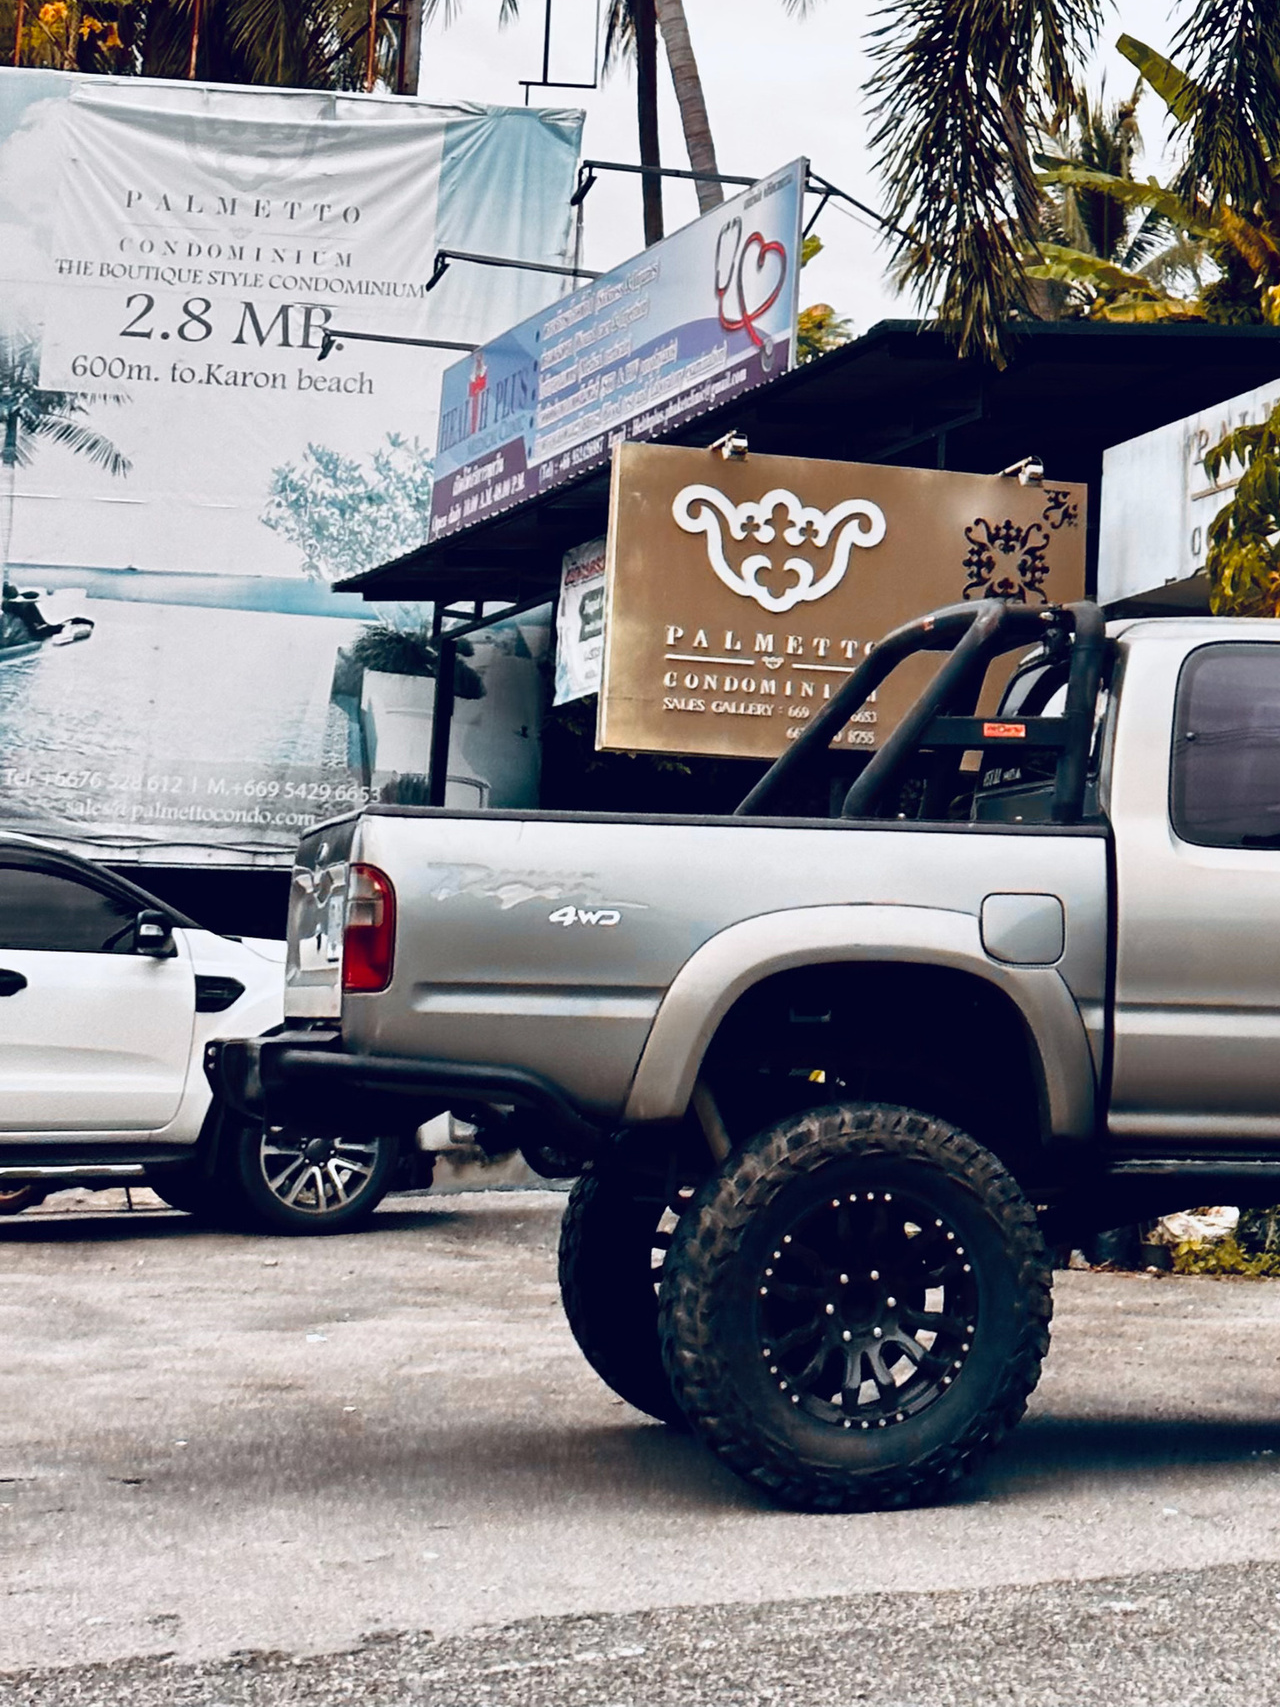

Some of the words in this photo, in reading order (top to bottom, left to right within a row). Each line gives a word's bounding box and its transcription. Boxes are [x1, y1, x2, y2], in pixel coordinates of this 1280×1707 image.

[127, 190, 361, 224] PALMETTO
[119, 237, 352, 267] CONDOMINIUM
[55, 259, 93, 277] THE
[100, 263, 203, 285] BOUTIQUE
[208, 270, 264, 289] STYLE
[269, 274, 427, 299] CONDOMINIUM
[119, 293, 213, 342] 2.8
[72, 355, 160, 382] 600m.
[296, 368, 375, 394] beach
[441, 376, 490, 453] HEALTH
[494, 368, 529, 424] PLUS
[663, 671, 877, 703] CONDOMINI
[662, 697, 705, 711] SALES
[711, 700, 775, 717] GALLERY
[147, 774, 183, 793] 612
[284, 782, 331, 800] 5429
[334, 783, 381, 803] 6653
[549, 905, 622, 927] 4WD
